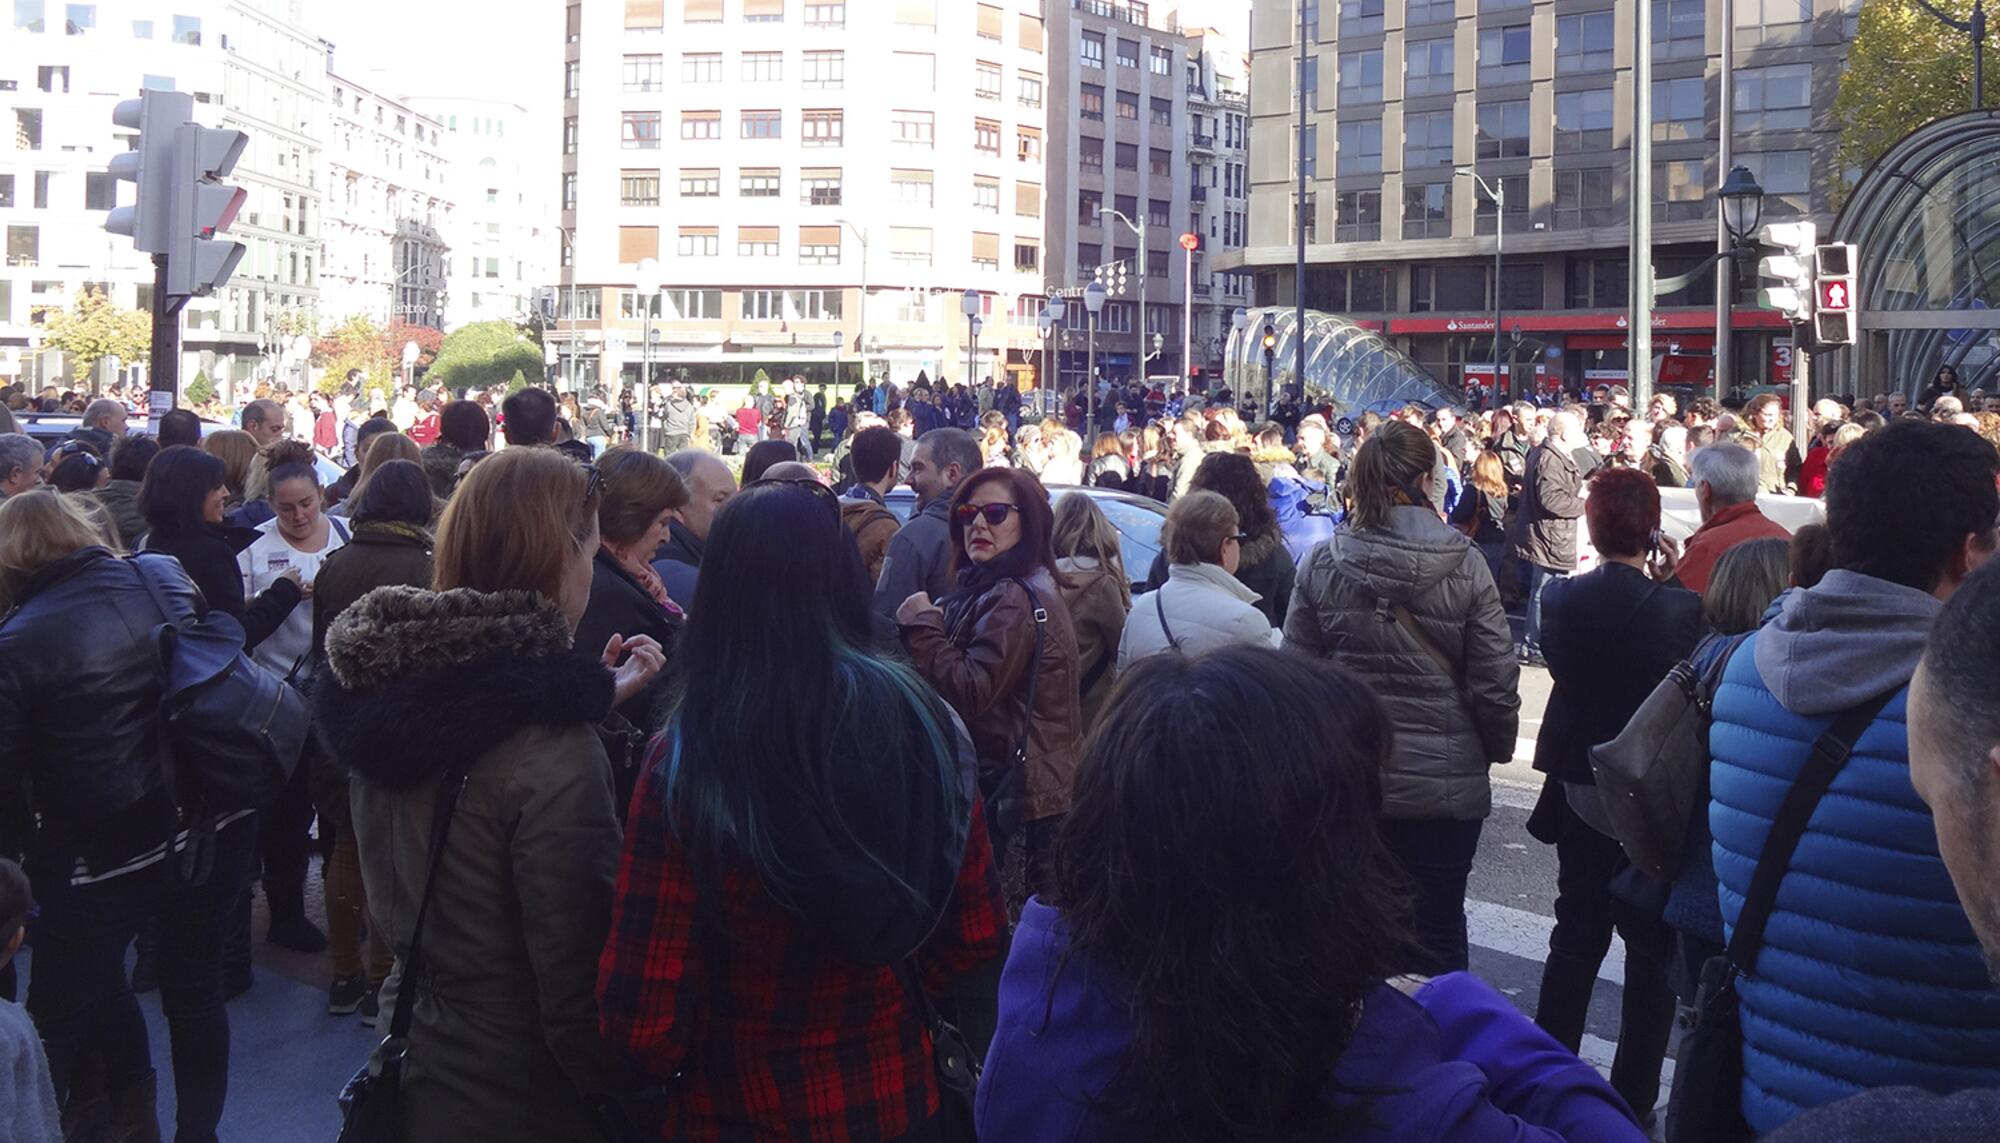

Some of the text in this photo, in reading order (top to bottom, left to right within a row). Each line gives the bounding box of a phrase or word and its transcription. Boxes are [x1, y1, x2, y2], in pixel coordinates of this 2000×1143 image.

[1046, 285, 1087, 298] Centr
[391, 303, 428, 314] entro
[1458, 320, 1496, 330] Santander
[1775, 346, 1791, 367] 3
